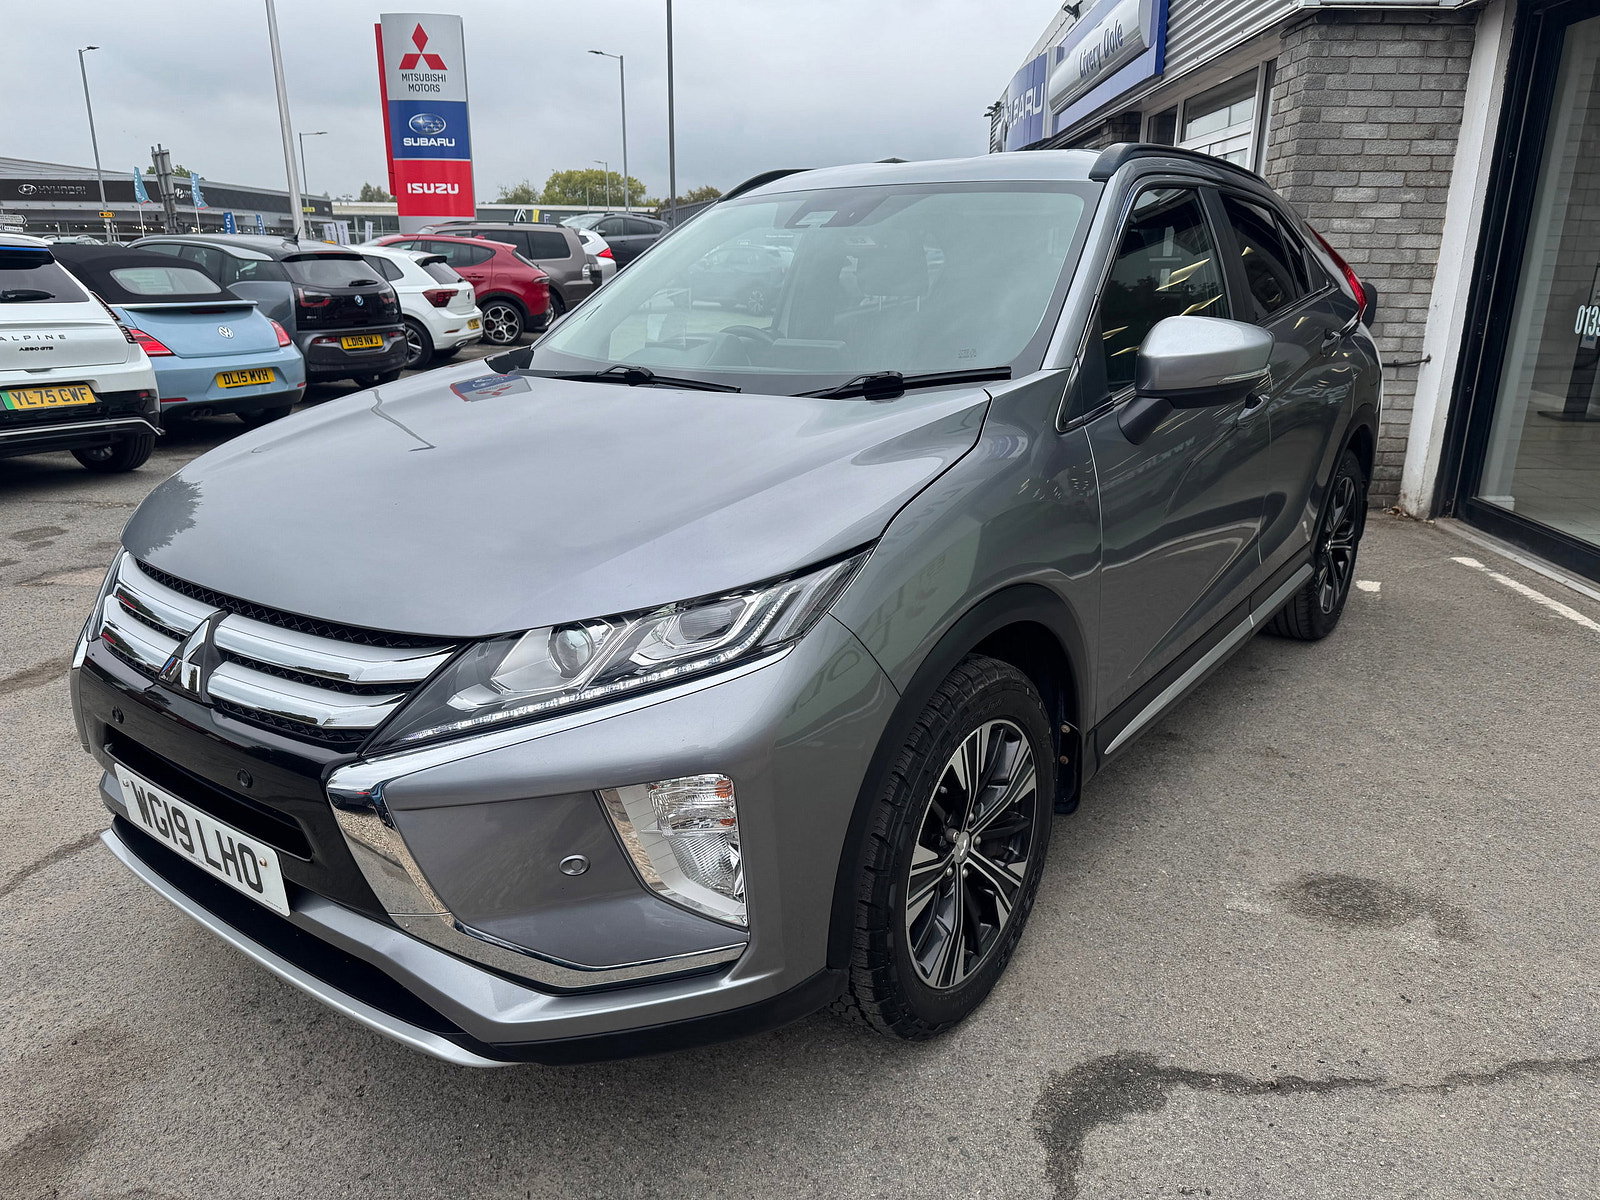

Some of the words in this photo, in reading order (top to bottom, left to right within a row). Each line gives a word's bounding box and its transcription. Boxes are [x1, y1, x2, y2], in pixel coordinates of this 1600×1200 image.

[1080, 43, 1102, 78] Livery
[1104, 19, 1123, 59] Dole
[401, 73, 447, 83] MITSUBISHI
[408, 84, 441, 93] MOTORS
[403, 137, 456, 147] SUBARU
[407, 182, 460, 195] ISUZU
[222, 371, 248, 385] DL15
[249, 369, 269, 382] MVH
[12, 389, 57, 406] YL75
[58, 387, 87, 402] CWF
[130, 780, 195, 855] WG19
